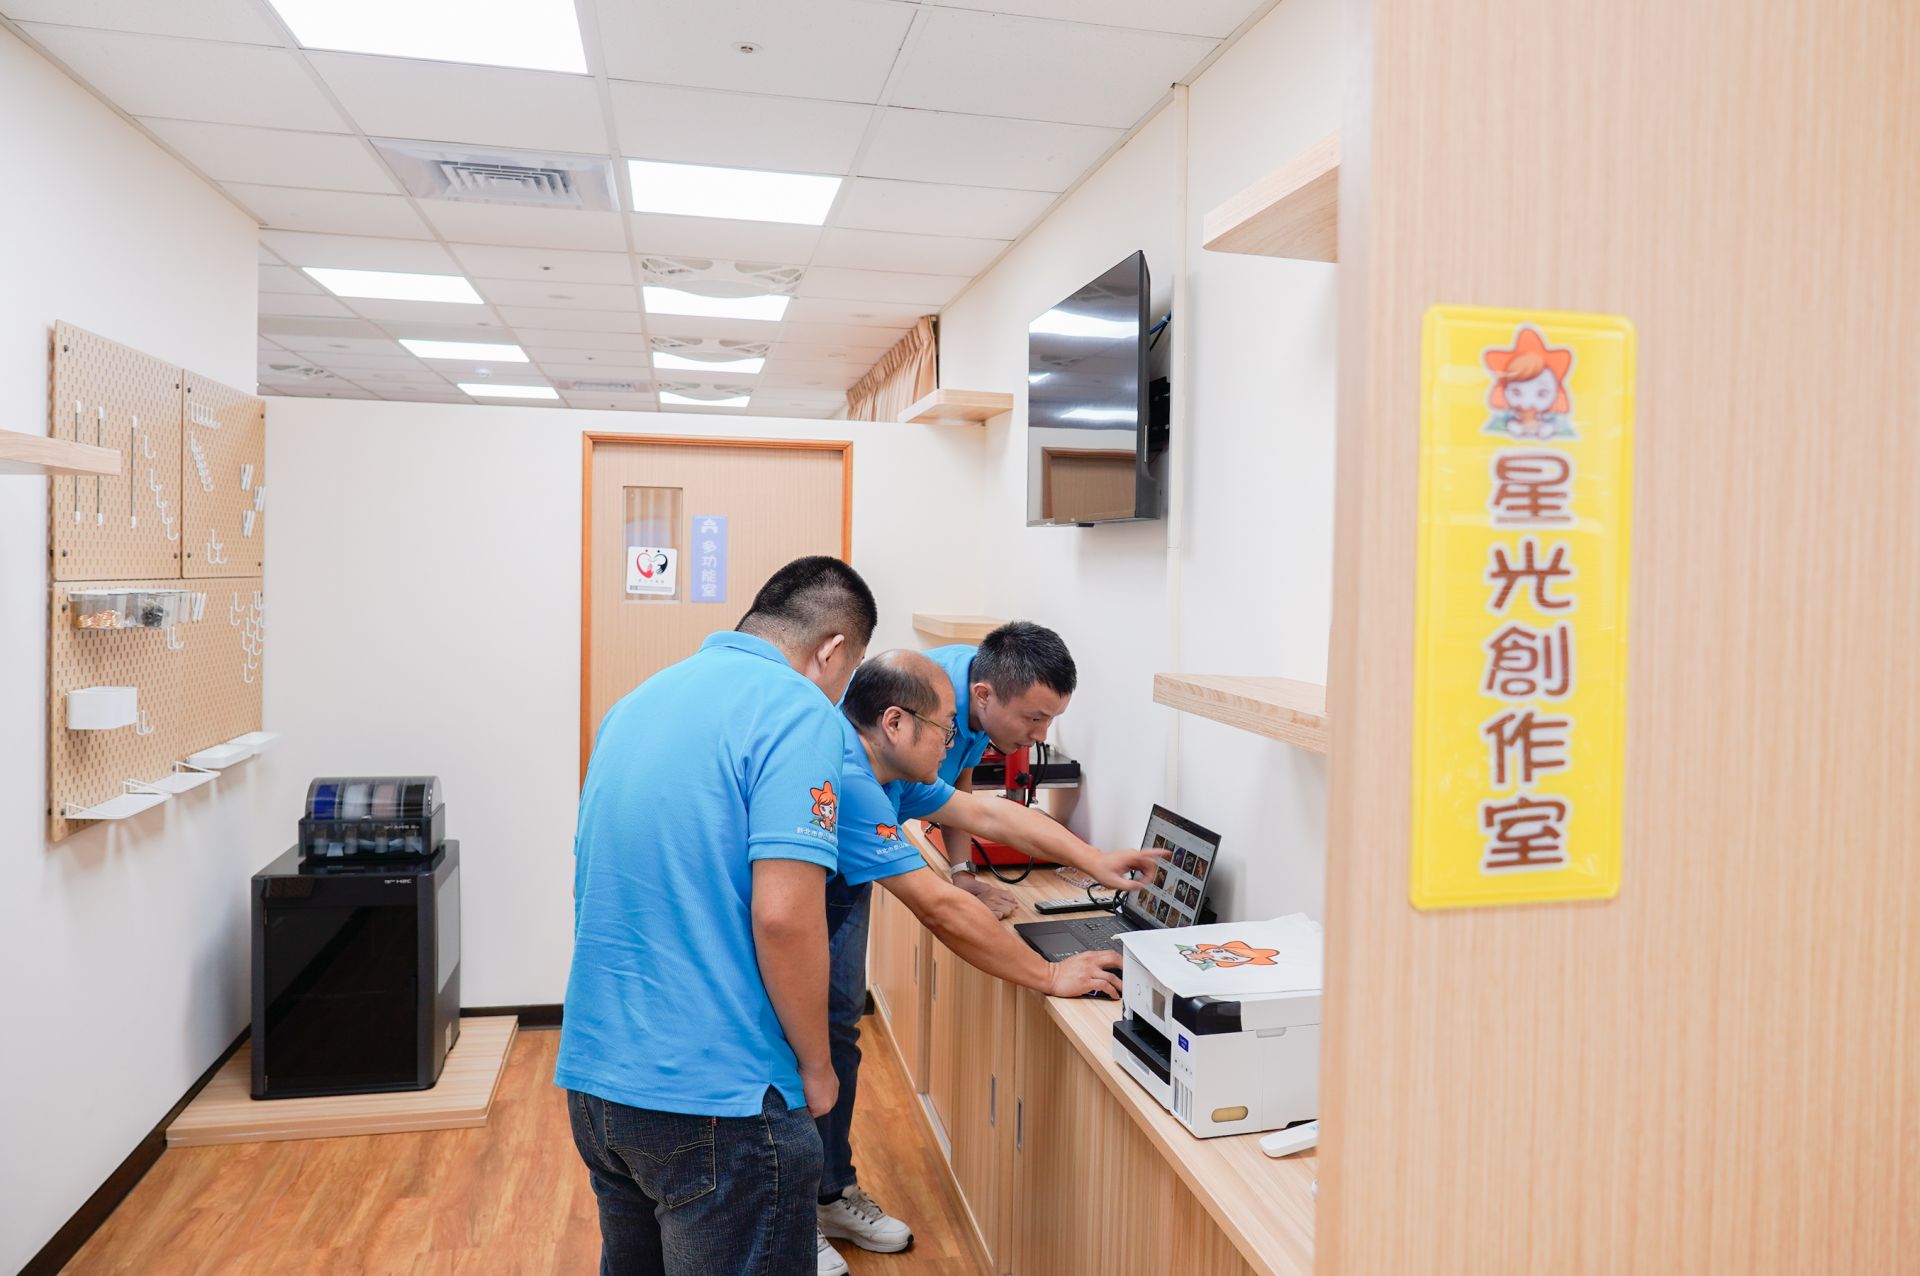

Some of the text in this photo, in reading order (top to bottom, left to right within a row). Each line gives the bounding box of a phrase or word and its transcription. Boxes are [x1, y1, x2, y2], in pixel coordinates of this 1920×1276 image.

[1485, 454, 1572, 869] 星光創作室
